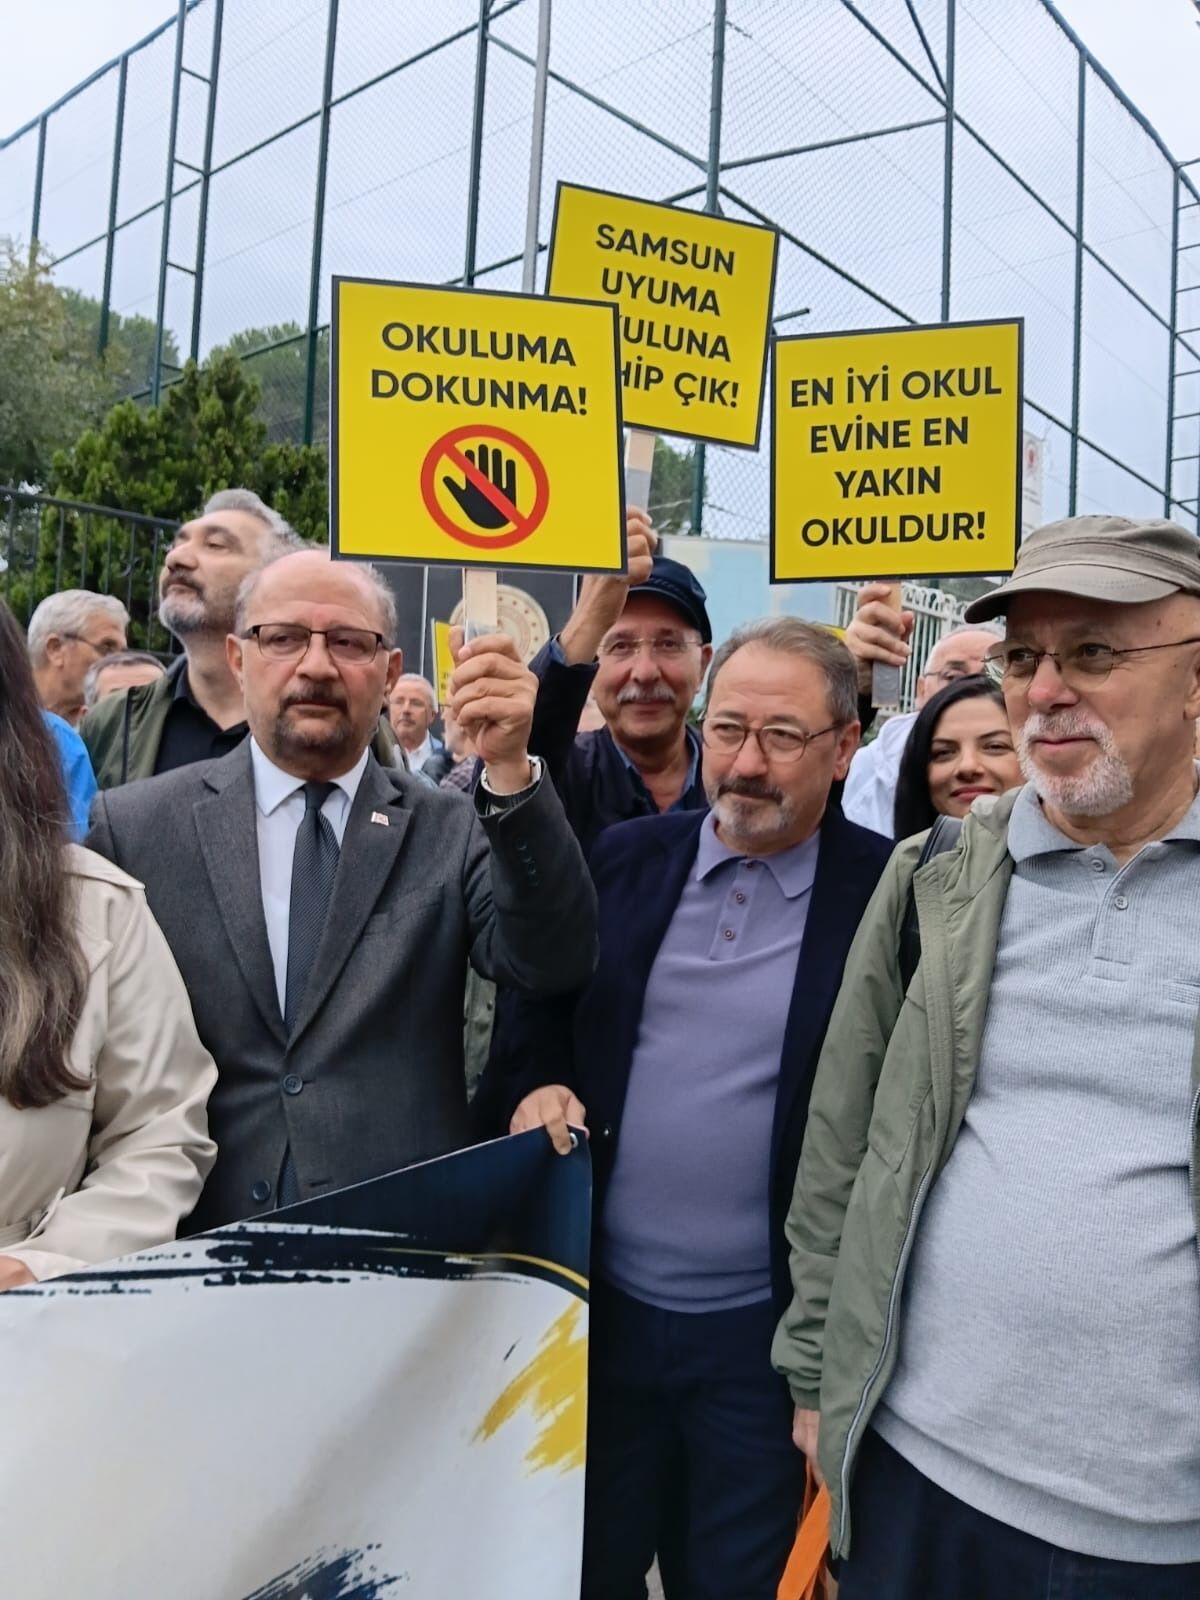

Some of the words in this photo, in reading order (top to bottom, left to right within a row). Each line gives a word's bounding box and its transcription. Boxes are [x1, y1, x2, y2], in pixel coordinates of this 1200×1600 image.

[596, 223, 735, 276] SAMSUN
[601, 267, 721, 317] UYUMA
[381, 322, 577, 367] OKULUMA
[619, 314, 731, 363] ULUNA
[371, 368, 587, 416] DOKUNMA!
[673, 371, 739, 409] ÇIK!
[790, 376, 834, 408] EN
[847, 364, 889, 404] İYİ
[901, 366, 1002, 400] OKUL
[810, 414, 911, 454] EVİNE
[923, 415, 969, 447] EN
[834, 465, 941, 499] YAKIN
[801, 511, 986, 547] OKULDUR!
